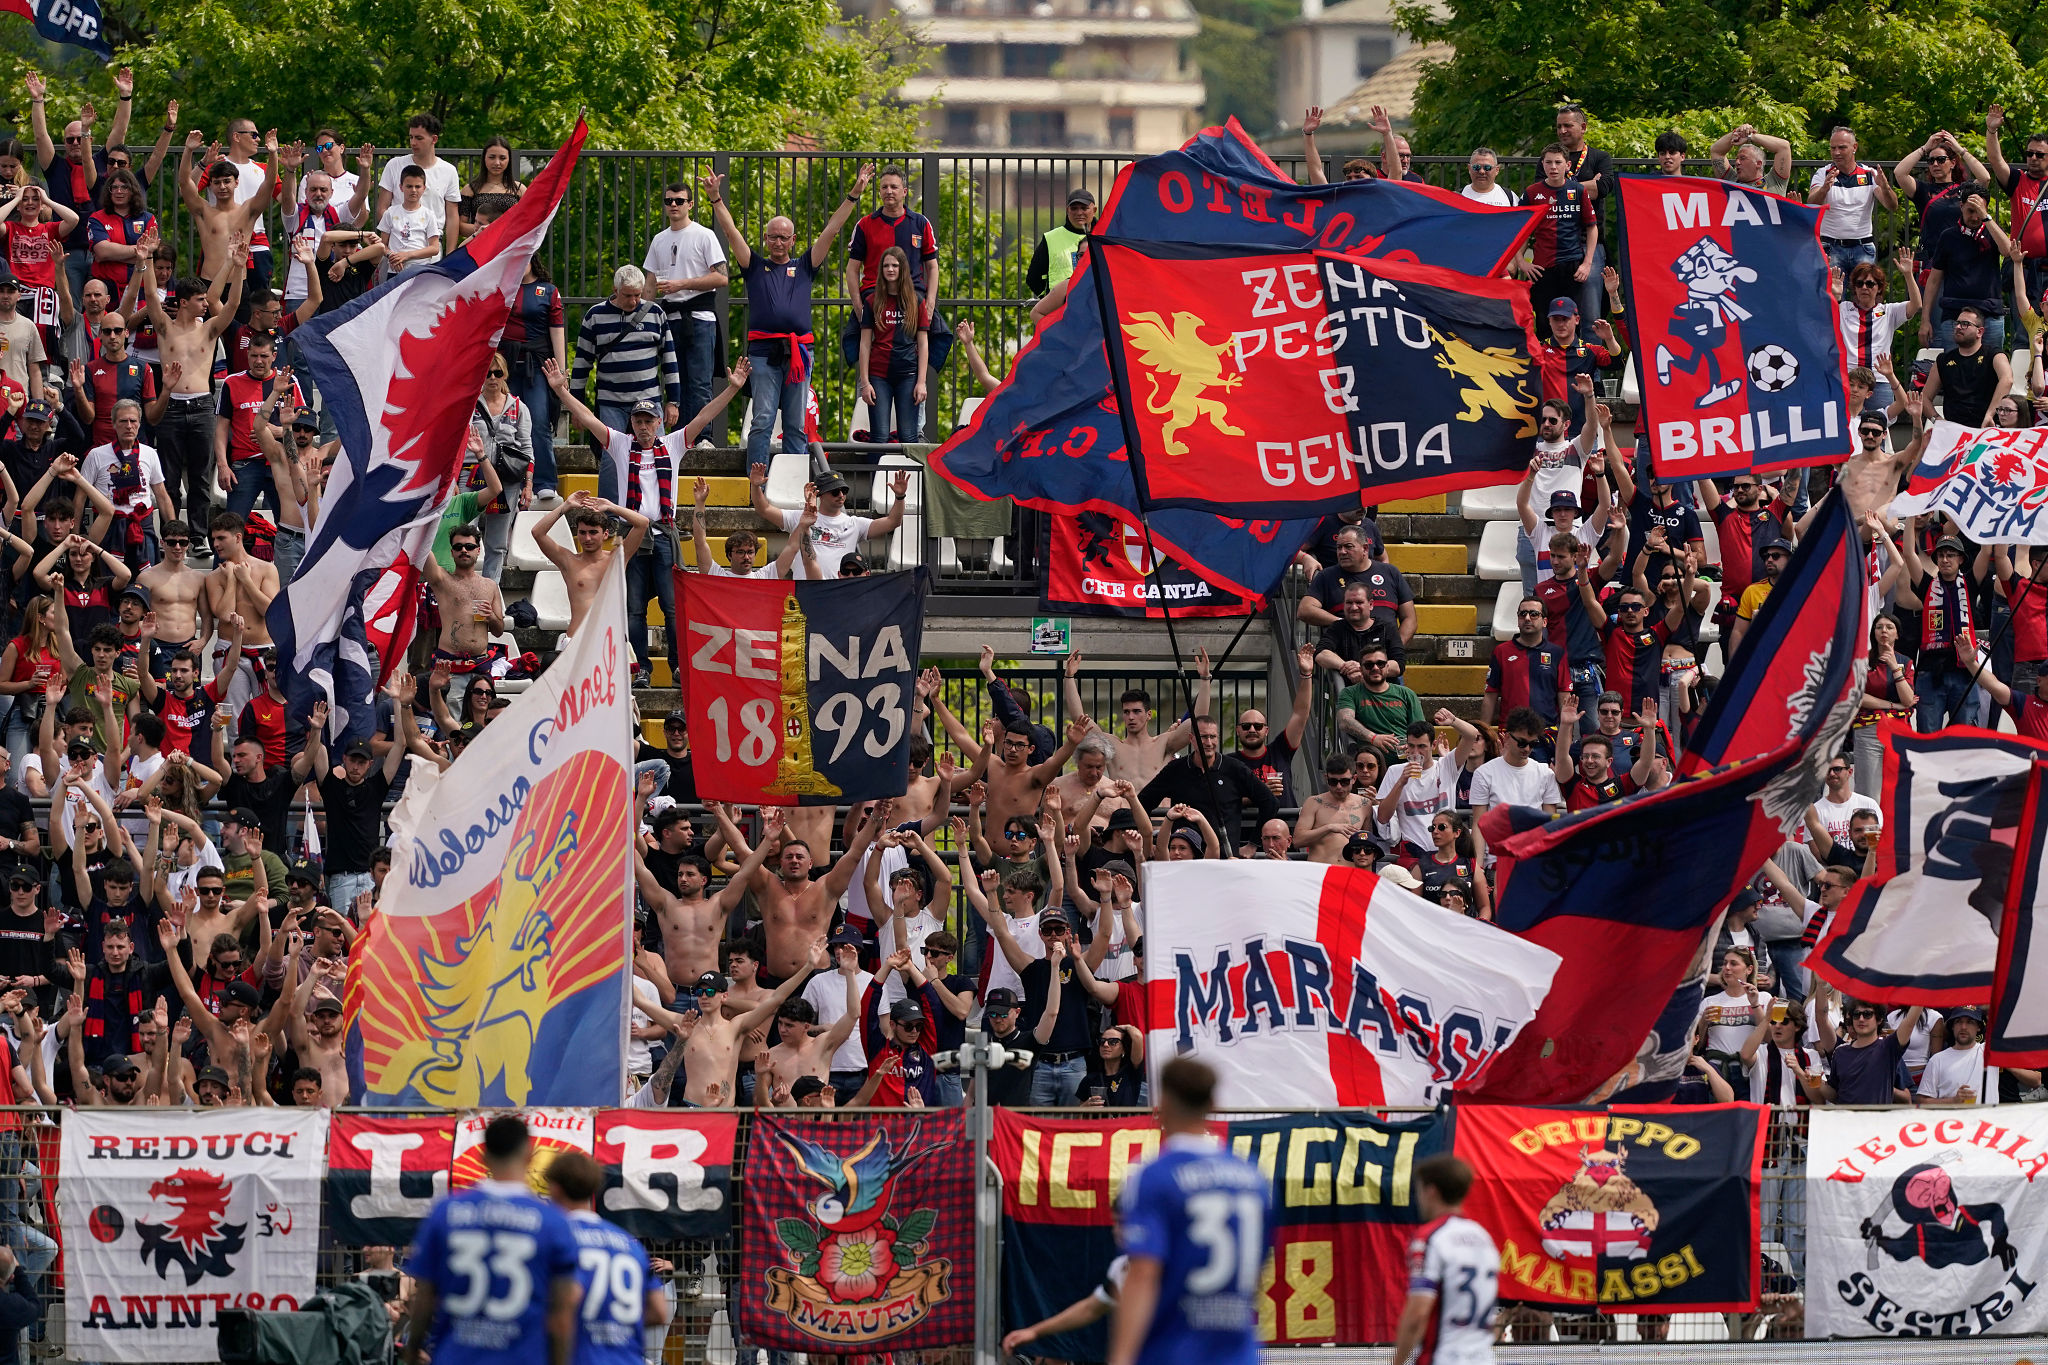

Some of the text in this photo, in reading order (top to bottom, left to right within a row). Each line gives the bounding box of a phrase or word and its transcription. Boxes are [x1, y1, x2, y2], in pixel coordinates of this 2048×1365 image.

[1661, 190, 1782, 230] MAI
[12, 250, 49, 260] 1893
[1232, 306, 1432, 373] PESTO
[1318, 365, 1360, 414] &
[1256, 421, 1453, 487] GENOA
[1658, 400, 1839, 461] BRILLI
[1081, 577, 1212, 600] CHE CANTA
[688, 619, 912, 682] ZENA
[1452, 641, 1468, 649] FILA
[1456, 649, 1465, 657] 13
[707, 683, 906, 767] 1893
[88, 1131, 298, 1160] REDUCI
[603, 1124, 724, 1212] R
[1509, 1116, 1702, 1161] GRUPPO
[1826, 1118, 2048, 1184] VECCHIA
[351, 1131, 450, 1219] L
[1183, 1191, 1265, 1296] 31
[1499, 1239, 1706, 1302] MARASSI
[444, 1229, 538, 1322] 33
[577, 1248, 644, 1325] 79
[1838, 1270, 2037, 1336] SESTRI
[82, 1293, 232, 1329] ANNI
[798, 1294, 920, 1334] MAURI
